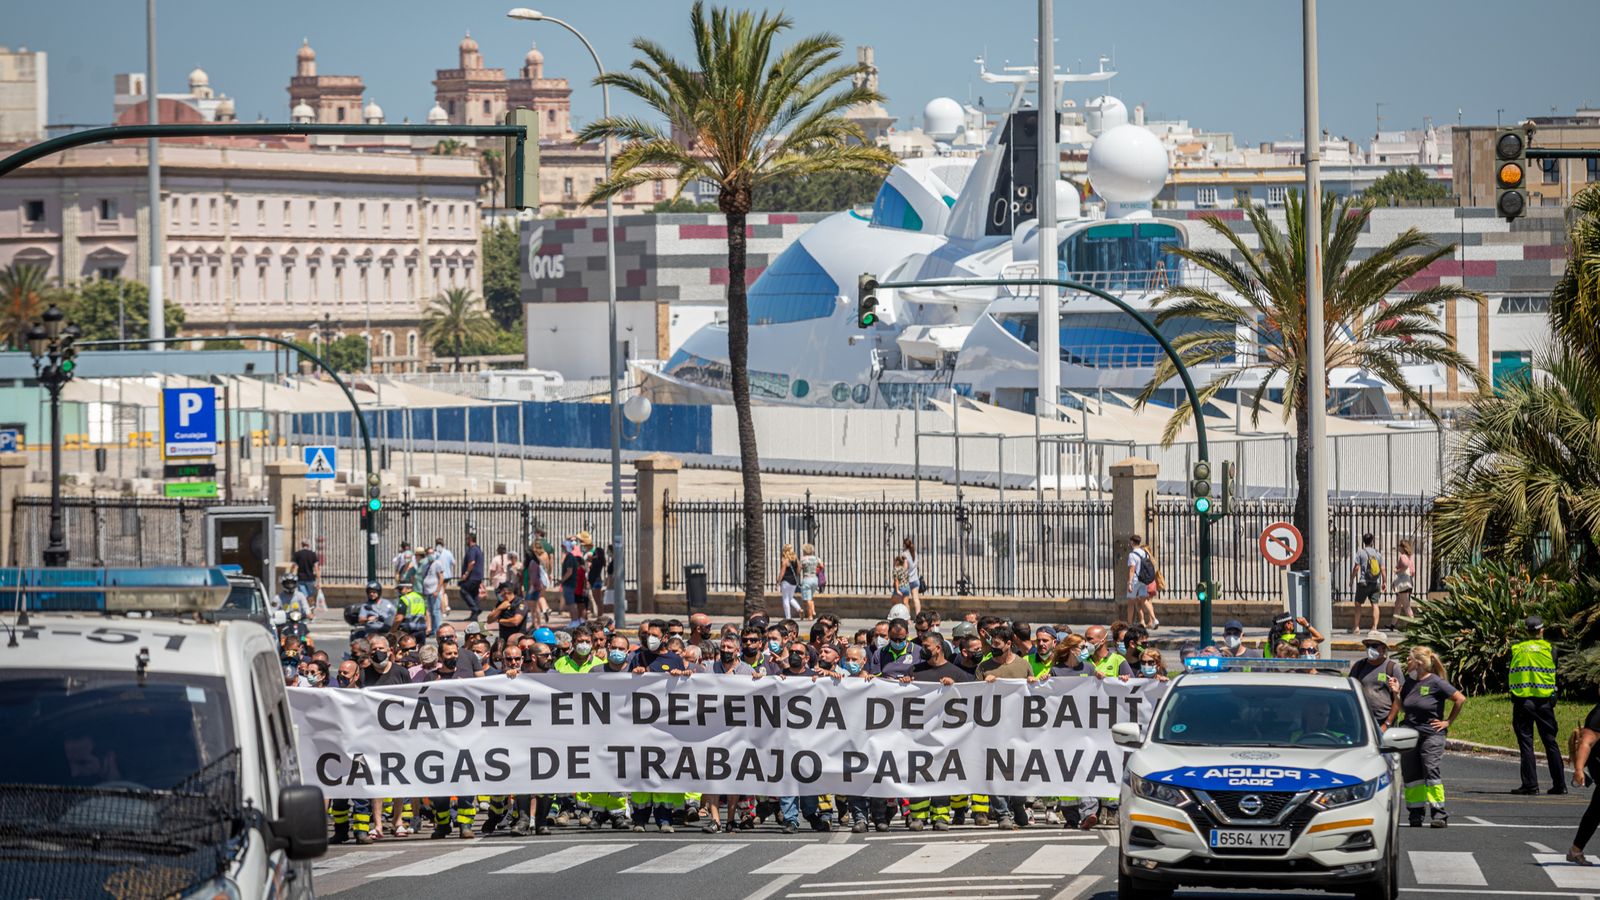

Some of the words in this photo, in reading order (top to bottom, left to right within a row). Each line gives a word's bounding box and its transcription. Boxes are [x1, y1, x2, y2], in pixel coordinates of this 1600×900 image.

[179, 392, 203, 427] P
[377, 686, 532, 732] CÁDIZ
[551, 692, 610, 726] EN
[632, 692, 847, 730] DEFENSA
[865, 697, 926, 731] DE
[942, 694, 1002, 729] SU
[1021, 686, 1164, 729] BAHÍ
[316, 747, 511, 787] CARGAS
[530, 746, 590, 780] DE
[607, 746, 823, 784] TRABAJO
[842, 749, 967, 784] PARA
[986, 748, 1133, 784] NAVA
[1220, 832, 1253, 846] 6564
[1260, 833, 1286, 847] KYZ
